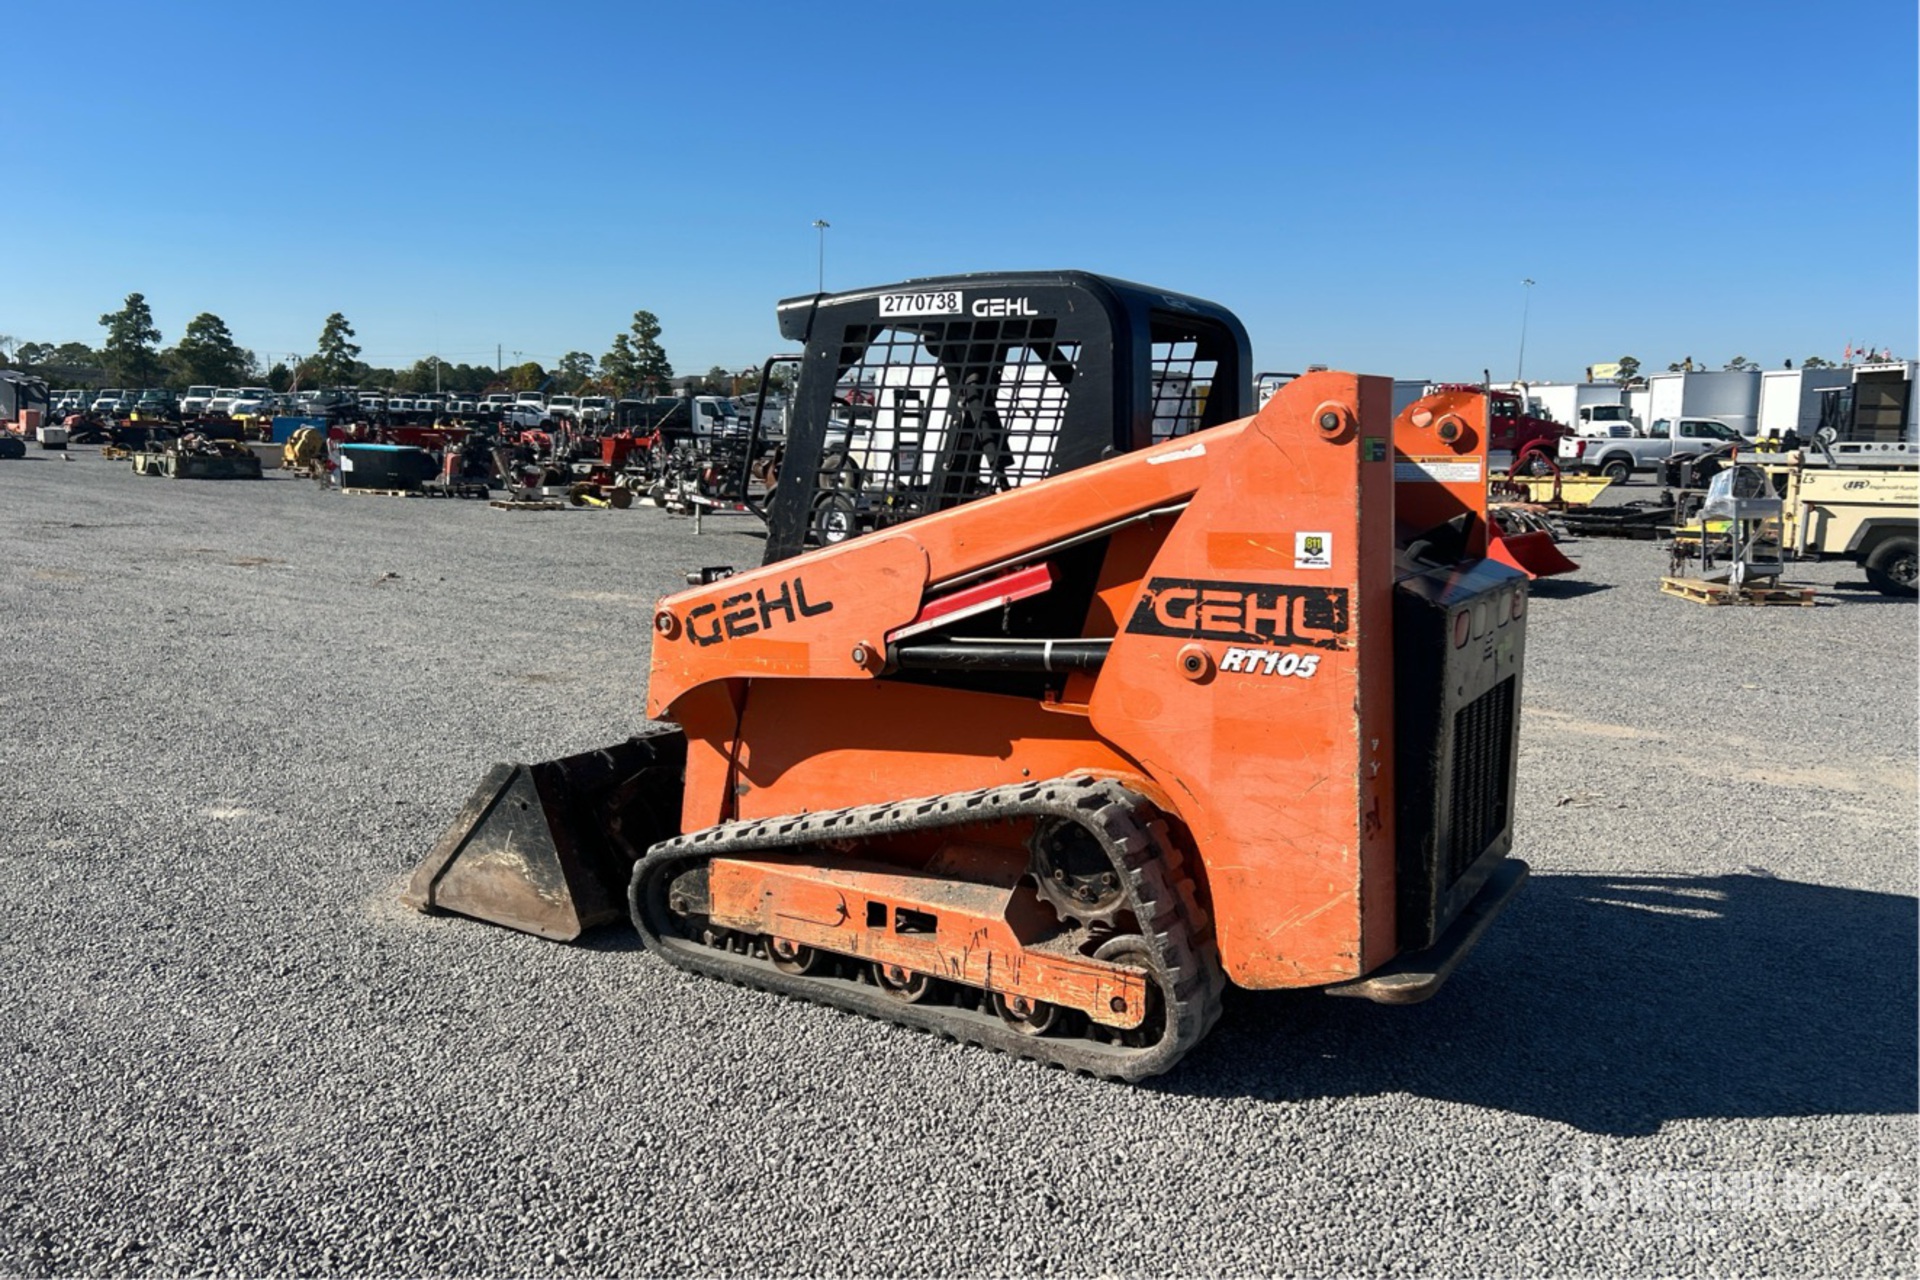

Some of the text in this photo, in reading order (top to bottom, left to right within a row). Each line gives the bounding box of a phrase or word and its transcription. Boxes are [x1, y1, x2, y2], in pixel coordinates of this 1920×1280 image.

[884, 292, 958, 312] 2770738
[972, 297, 1039, 317] GEHL
[1305, 537, 1322, 549] 811
[686, 577, 833, 647] GEHL
[1154, 587, 1339, 640] GEHL
[1219, 646, 1320, 679] RT105
